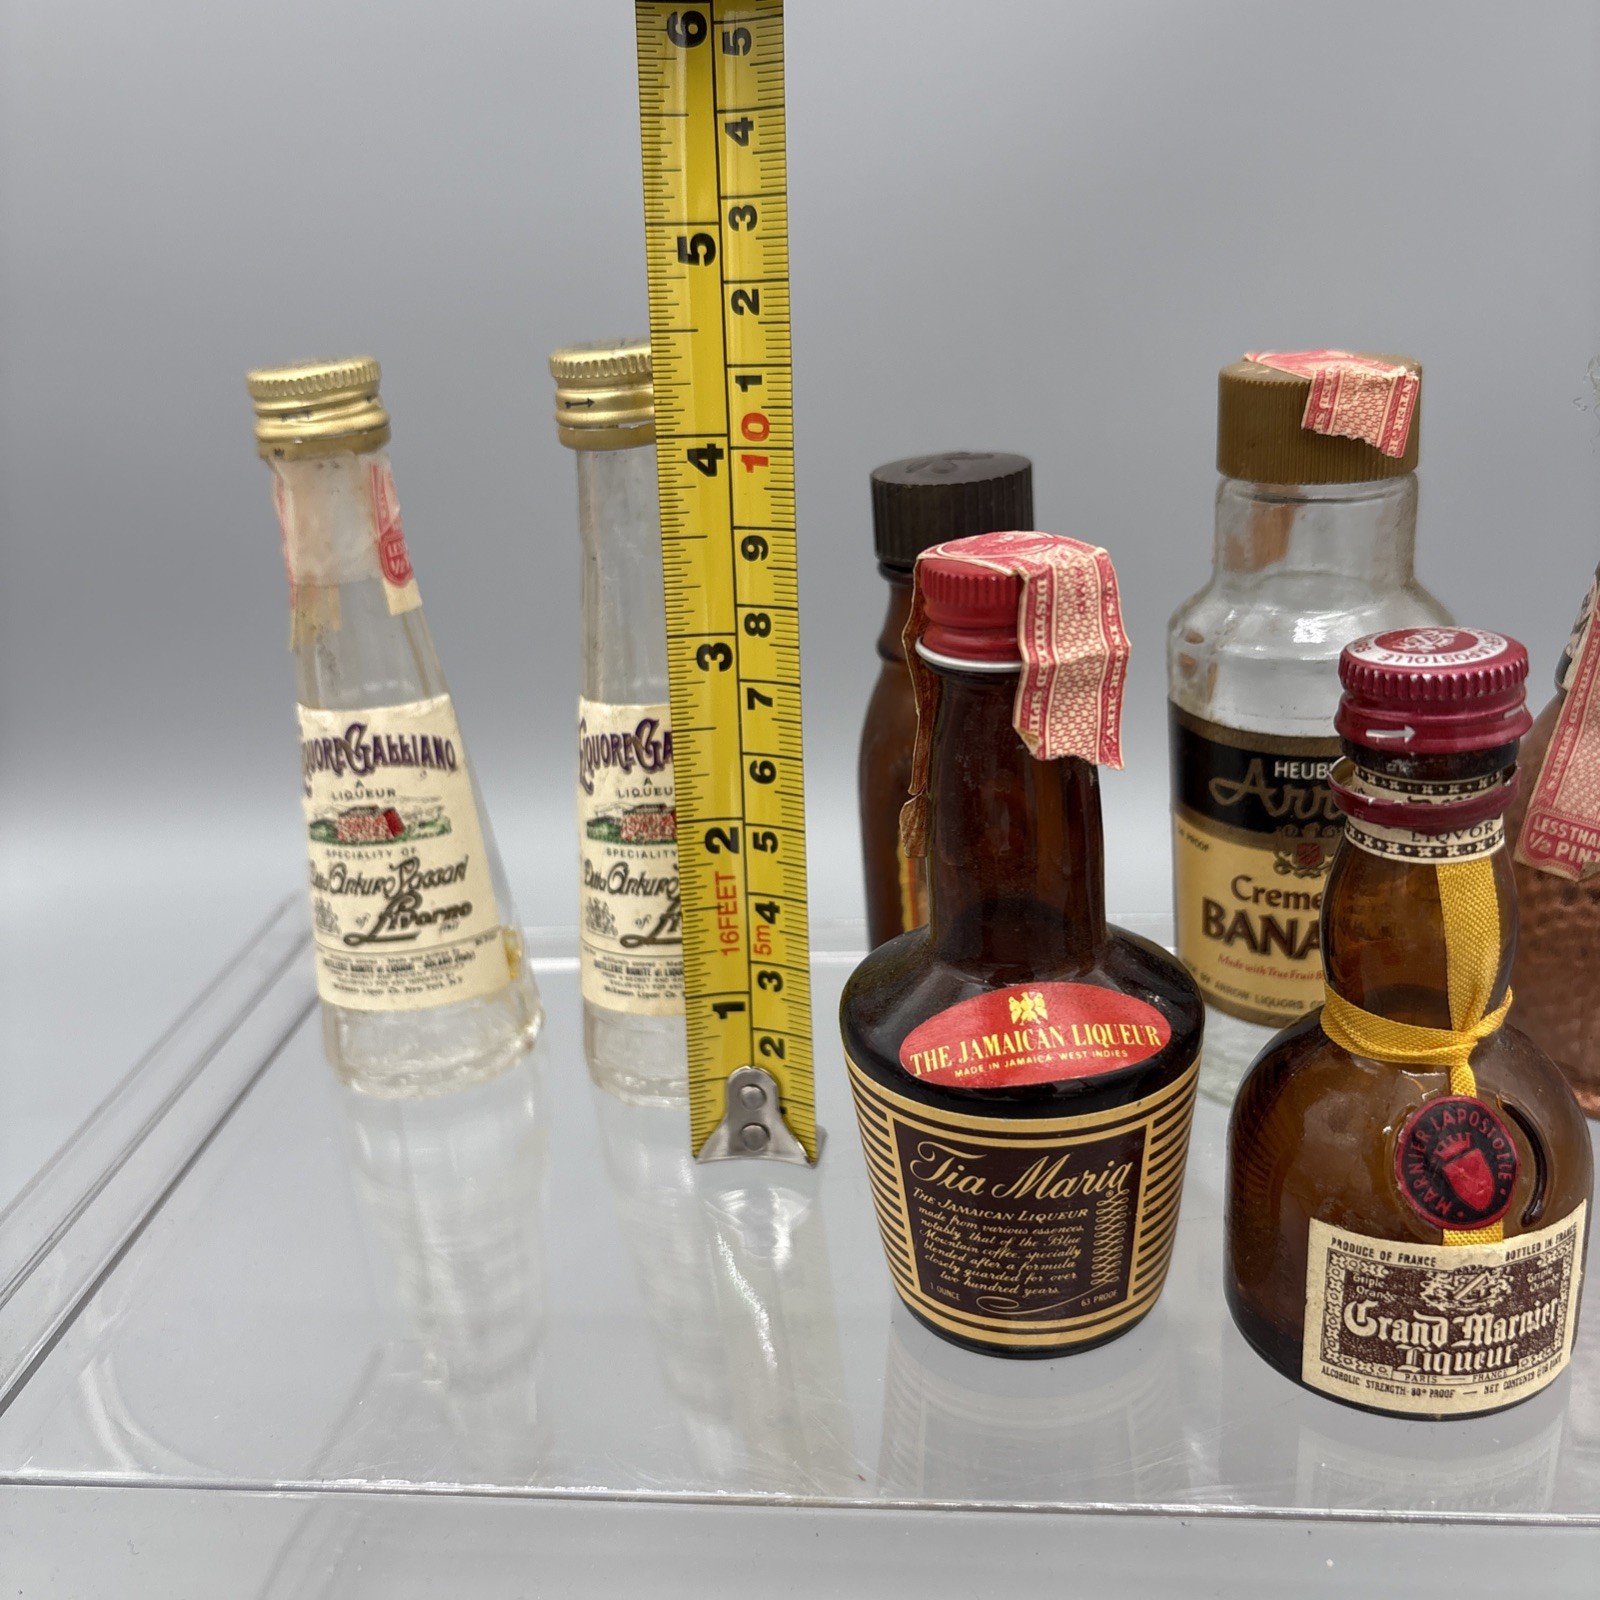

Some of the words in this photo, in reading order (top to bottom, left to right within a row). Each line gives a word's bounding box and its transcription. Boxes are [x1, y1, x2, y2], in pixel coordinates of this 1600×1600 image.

[666, 10, 708, 49] 6
[722, 27, 752, 56] 5
[724, 117, 754, 147] 4
[728, 204, 758, 232] 3
[677, 231, 717, 268] 5
[731, 288, 760, 317] 2
[735, 375, 762, 392] 1
[687, 443, 724, 477] 4
[741, 535, 769, 561] 9
[744, 612, 772, 638] 8
[696, 642, 733, 672] 3
[747, 687, 773, 711] 7
[643, 777, 653, 786] A
[749, 760, 777, 784] 6
[1274, 761, 1333, 780] HEUB
[331, 788, 397, 801] LIQUEUR
[617, 787, 673, 798] LIQUEU
[705, 826, 740, 854] 2
[752, 831, 778, 854] 5
[1231, 875, 1323, 910] Creme
[755, 901, 781, 925] 4
[754, 924, 772, 957] 5m
[1202, 896, 1322, 960] BANA
[757, 970, 784, 993] 3
[712, 1001, 746, 1020] 1
[759, 1035, 786, 1060] 2
[910, 1046, 952, 1076] THE
[957, 1025, 1066, 1064] JAMAICAN
[1071, 1023, 1162, 1048] LIQUEUR
[954, 1064, 985, 1078] MADE
[988, 1062, 1000, 1070] IN
[1004, 1053, 1053, 1068] JAMAICA
[1060, 1050, 1088, 1061] WEST
[1092, 1049, 1128, 1059] INDIES
[910, 1141, 988, 1196] Tia
[991, 1153, 1134, 1200] Maria
[1408, 1130, 1453, 1215] MARNIER
[912, 1186, 936, 1205] THE
[937, 1199, 1016, 1220] JAMAICAN
[1018, 1208, 1089, 1224] LIQUEUR
[918, 1206, 947, 1222] made
[948, 1214, 978, 1230] from
[982, 1224, 1029, 1235] various
[920, 1218, 962, 1240] notably
[969, 1231, 996, 1244] that
[1000, 1236, 1016, 1248] of
[1019, 1236, 1039, 1247] the
[919, 1228, 979, 1254] Mountain
[1025, 1245, 1081, 1262] specially
[1331, 1237, 1375, 1258] PRODUCE
[1380, 1250, 1392, 1261] OF
[1398, 1253, 1437, 1268] FRANCE
[1505, 1242, 1541, 1261] BOTTLED
[1544, 1237, 1552, 1249] IN
[1555, 1221, 1577, 1244] FRANCE
[924, 1239, 967, 1262] blended
[970, 1257, 1001, 1269] after
[1006, 1263, 1016, 1271] a
[1018, 1258, 1076, 1277] formula
[925, 1253, 960, 1274] closely
[963, 1268, 1020, 1282] guarded
[1024, 1272, 1043, 1285] for
[1050, 1272, 1077, 1281] over
[936, 1285, 961, 1301] OUNCE
[940, 1270, 960, 1283] two
[963, 1276, 1020, 1294] hundred
[1093, 1289, 1119, 1304] PROOF
[1343, 1299, 1449, 1348] Grand
[1451, 1297, 1560, 1348] Marnier
[1396, 1342, 1519, 1376] Liqueur
[1366, 1379, 1406, 1396] STRENGTH
[1429, 1389, 1455, 1398] PROOF
[1484, 1383, 1499, 1394] NET
[1503, 1371, 1535, 1390] CONTENTS
[1405, 1374, 1438, 1384] PARIS
[1472, 1369, 1509, 1384] FRANCE
